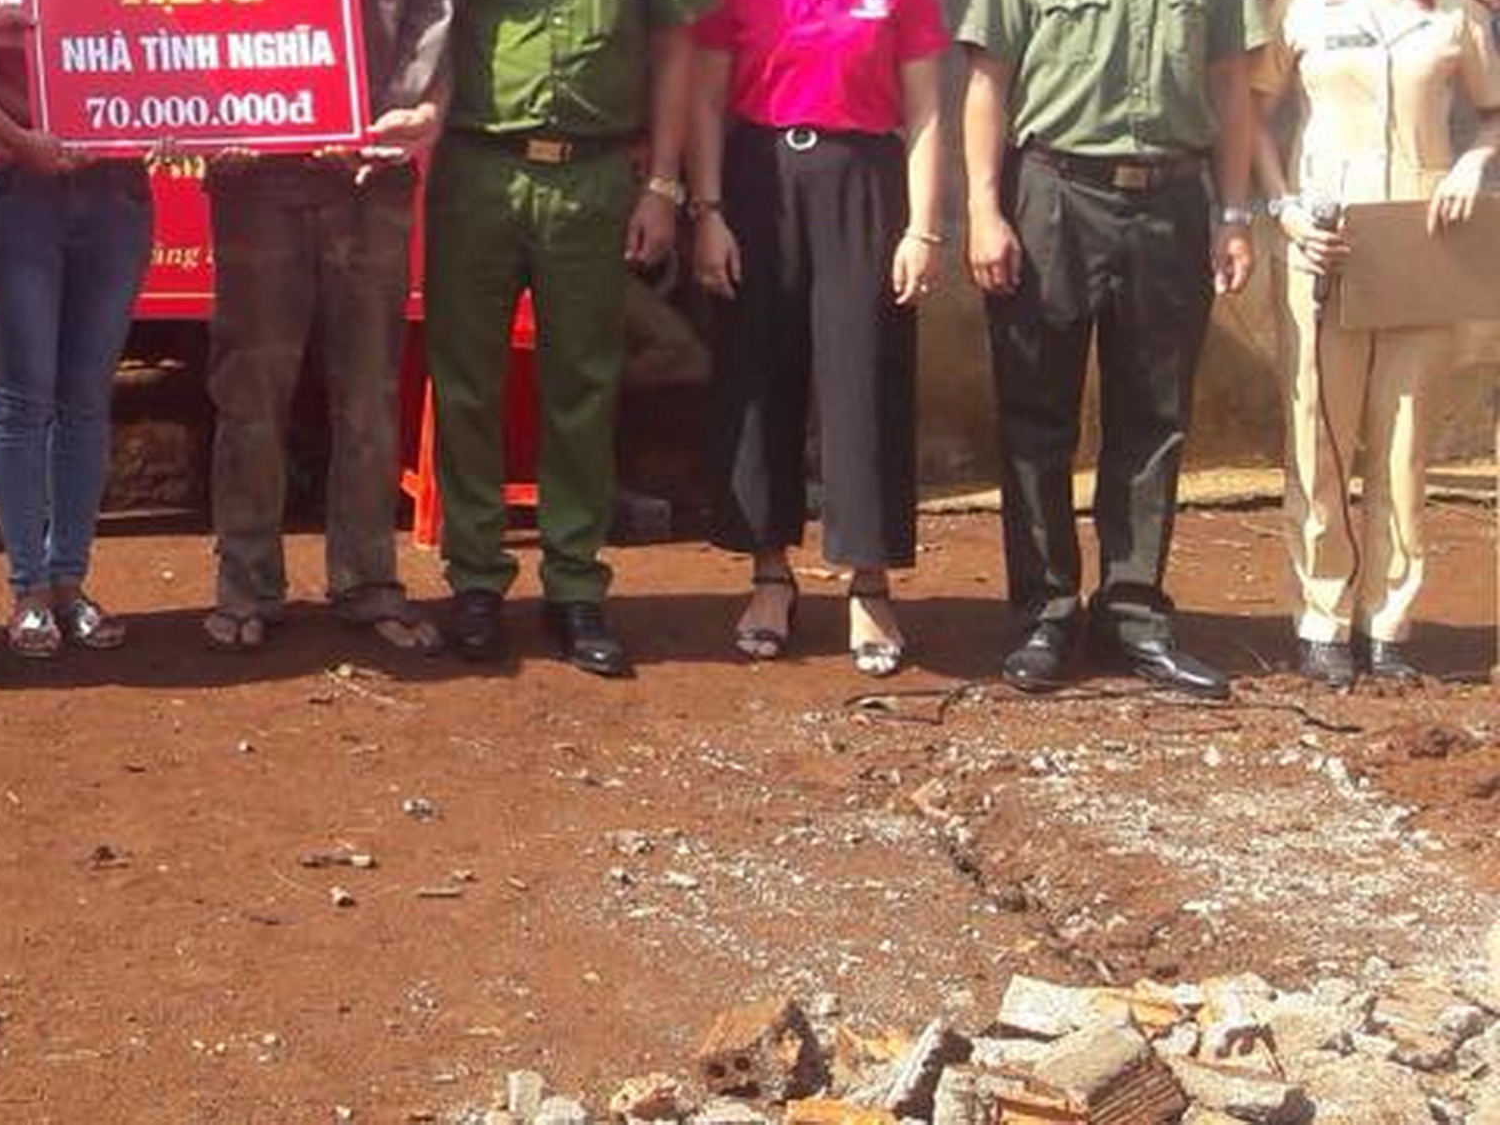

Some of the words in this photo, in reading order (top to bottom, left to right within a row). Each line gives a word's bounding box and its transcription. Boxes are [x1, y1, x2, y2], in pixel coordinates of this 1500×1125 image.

[62, 30, 132, 72] NHÀ
[141, 28, 218, 71] TÌNH
[228, 25, 336, 69] NGHĨA
[86, 90, 315, 130] 70.000.000đ
